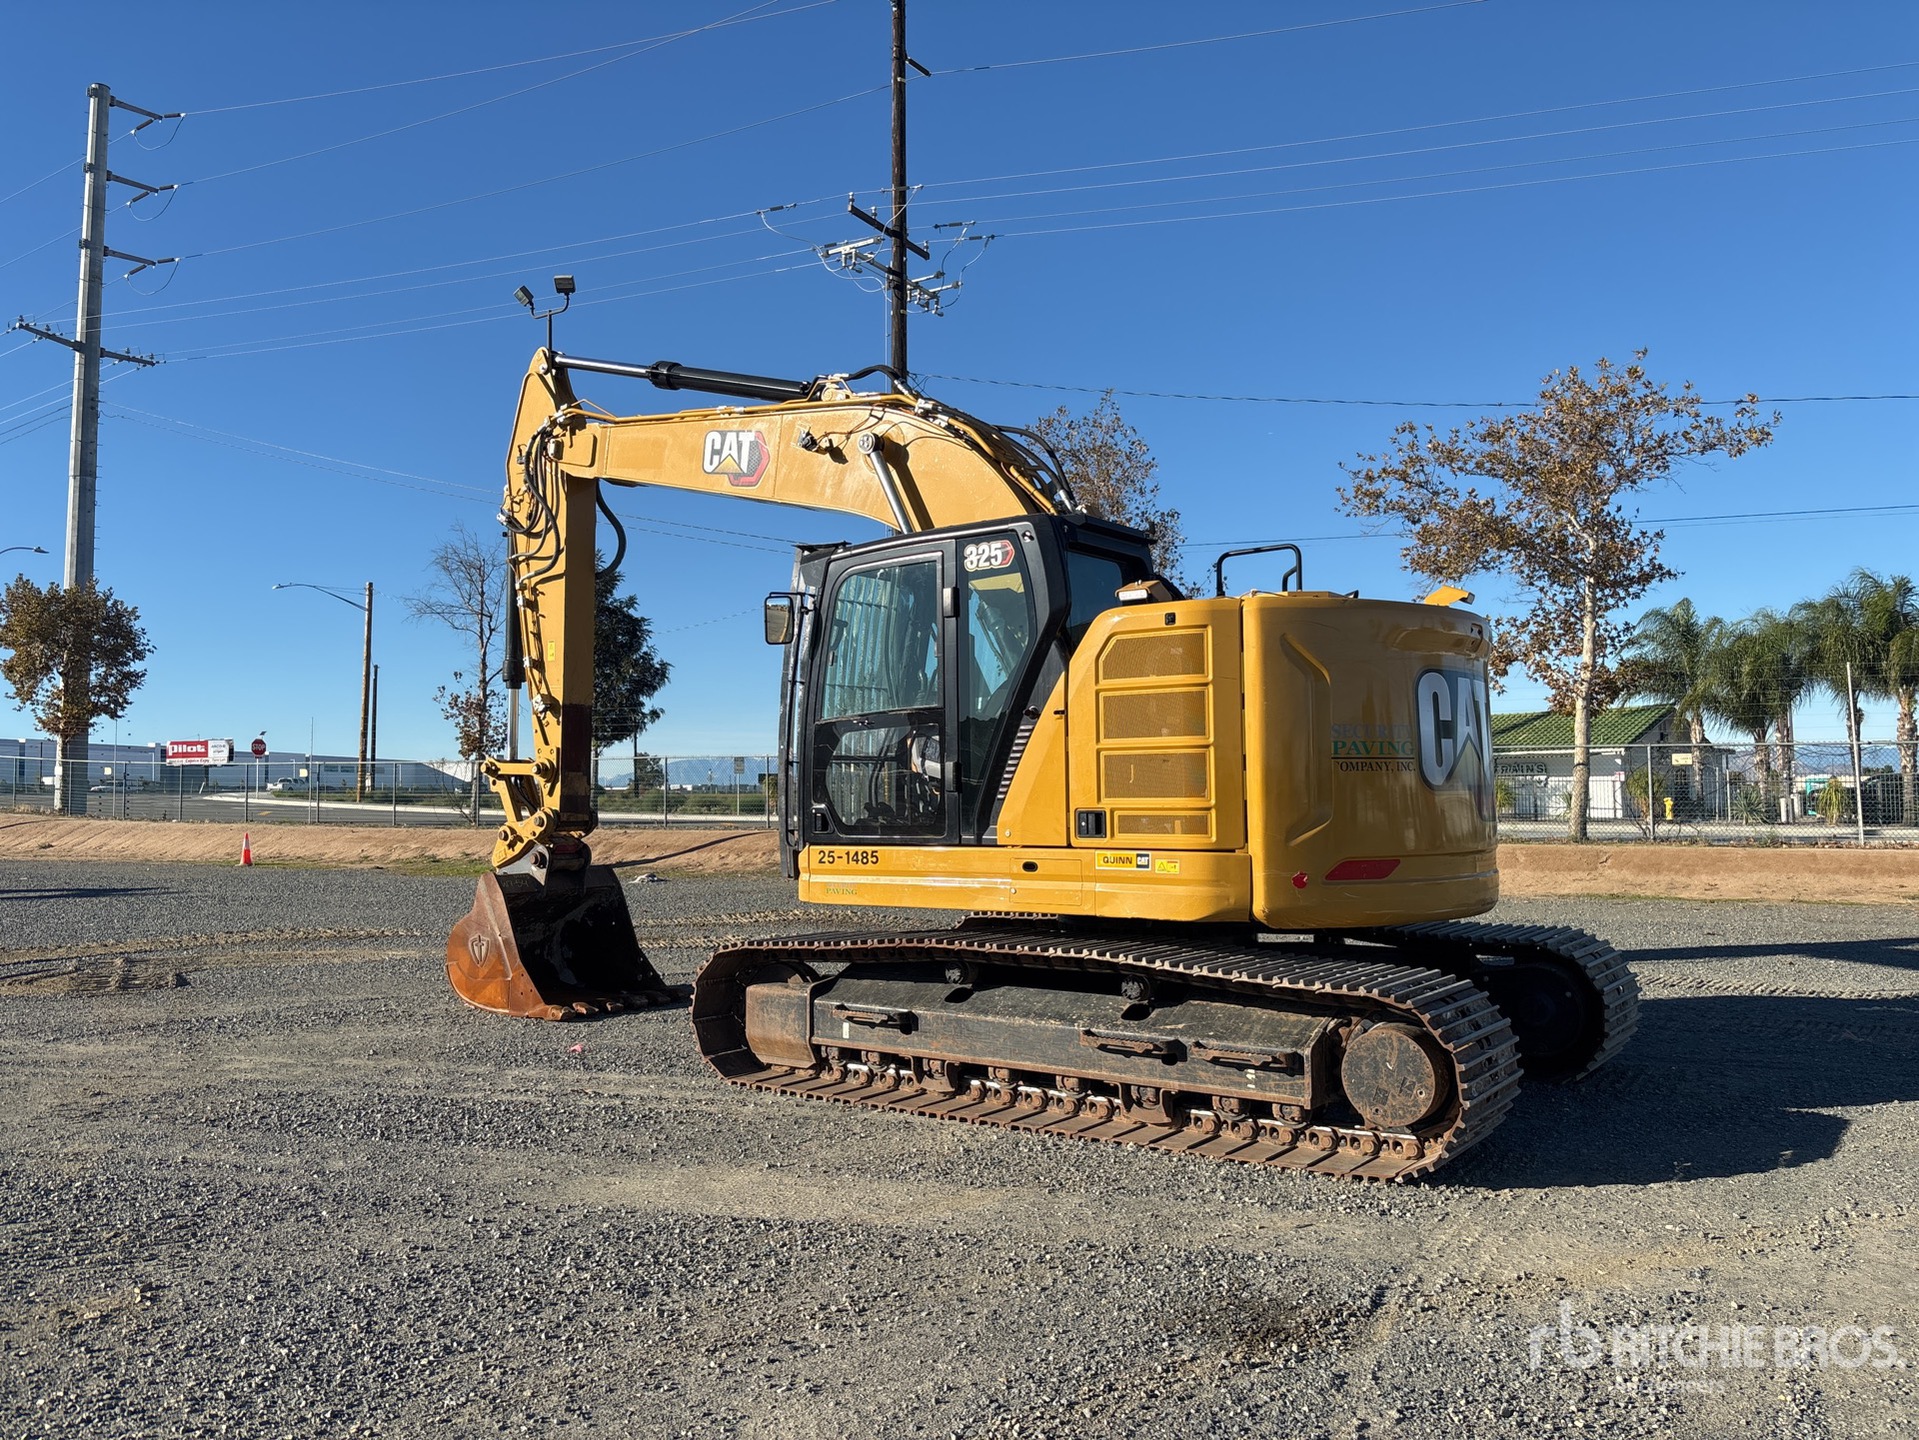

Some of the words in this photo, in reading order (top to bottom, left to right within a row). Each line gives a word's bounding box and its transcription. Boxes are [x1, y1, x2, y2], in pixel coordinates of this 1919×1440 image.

[703, 430, 756, 474] CAT
[964, 543, 1003, 570] 325
[1417, 671, 1492, 786] CAT
[252, 743, 265, 751] STOP
[1332, 740, 1415, 756] PAVING
[1336, 760, 1394, 773] OMPANY,
[1396, 760, 1416, 772] INC.
[818, 850, 879, 865] 25-1485
[1102, 856, 1133, 865] QUINN
